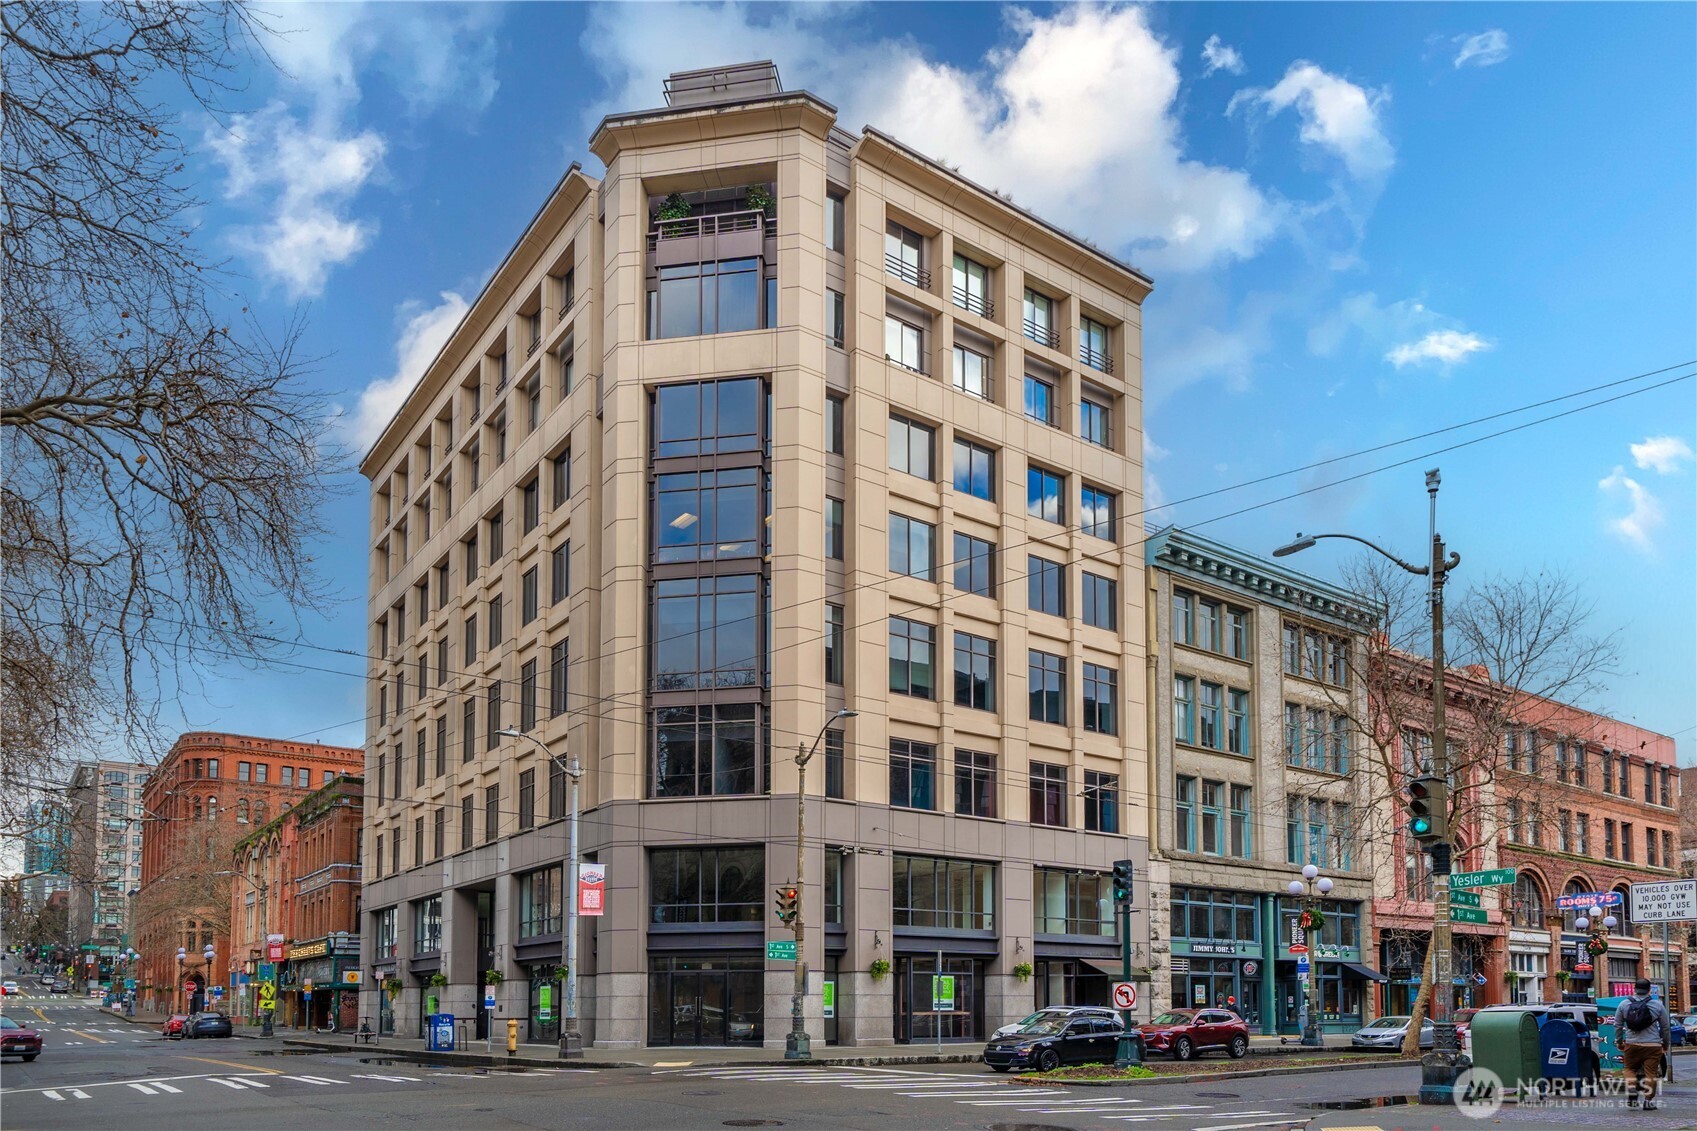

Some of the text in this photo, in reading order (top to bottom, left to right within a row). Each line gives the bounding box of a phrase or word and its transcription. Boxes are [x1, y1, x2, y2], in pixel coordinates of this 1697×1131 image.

[1452, 874, 1504, 886] Yesler Wy
[1635, 885, 1670, 894] VEHICLES
[1457, 893, 1466, 903] Ave
[1469, 895, 1473, 904] S
[1670, 893, 1686, 901] GVW
[1560, 897, 1597, 907] ROOMS
[1657, 902, 1672, 910] NOT
[1676, 901, 1691, 909] USE
[1466, 911, 1476, 920] Ave
[1643, 910, 1686, 919] CURB LANE
